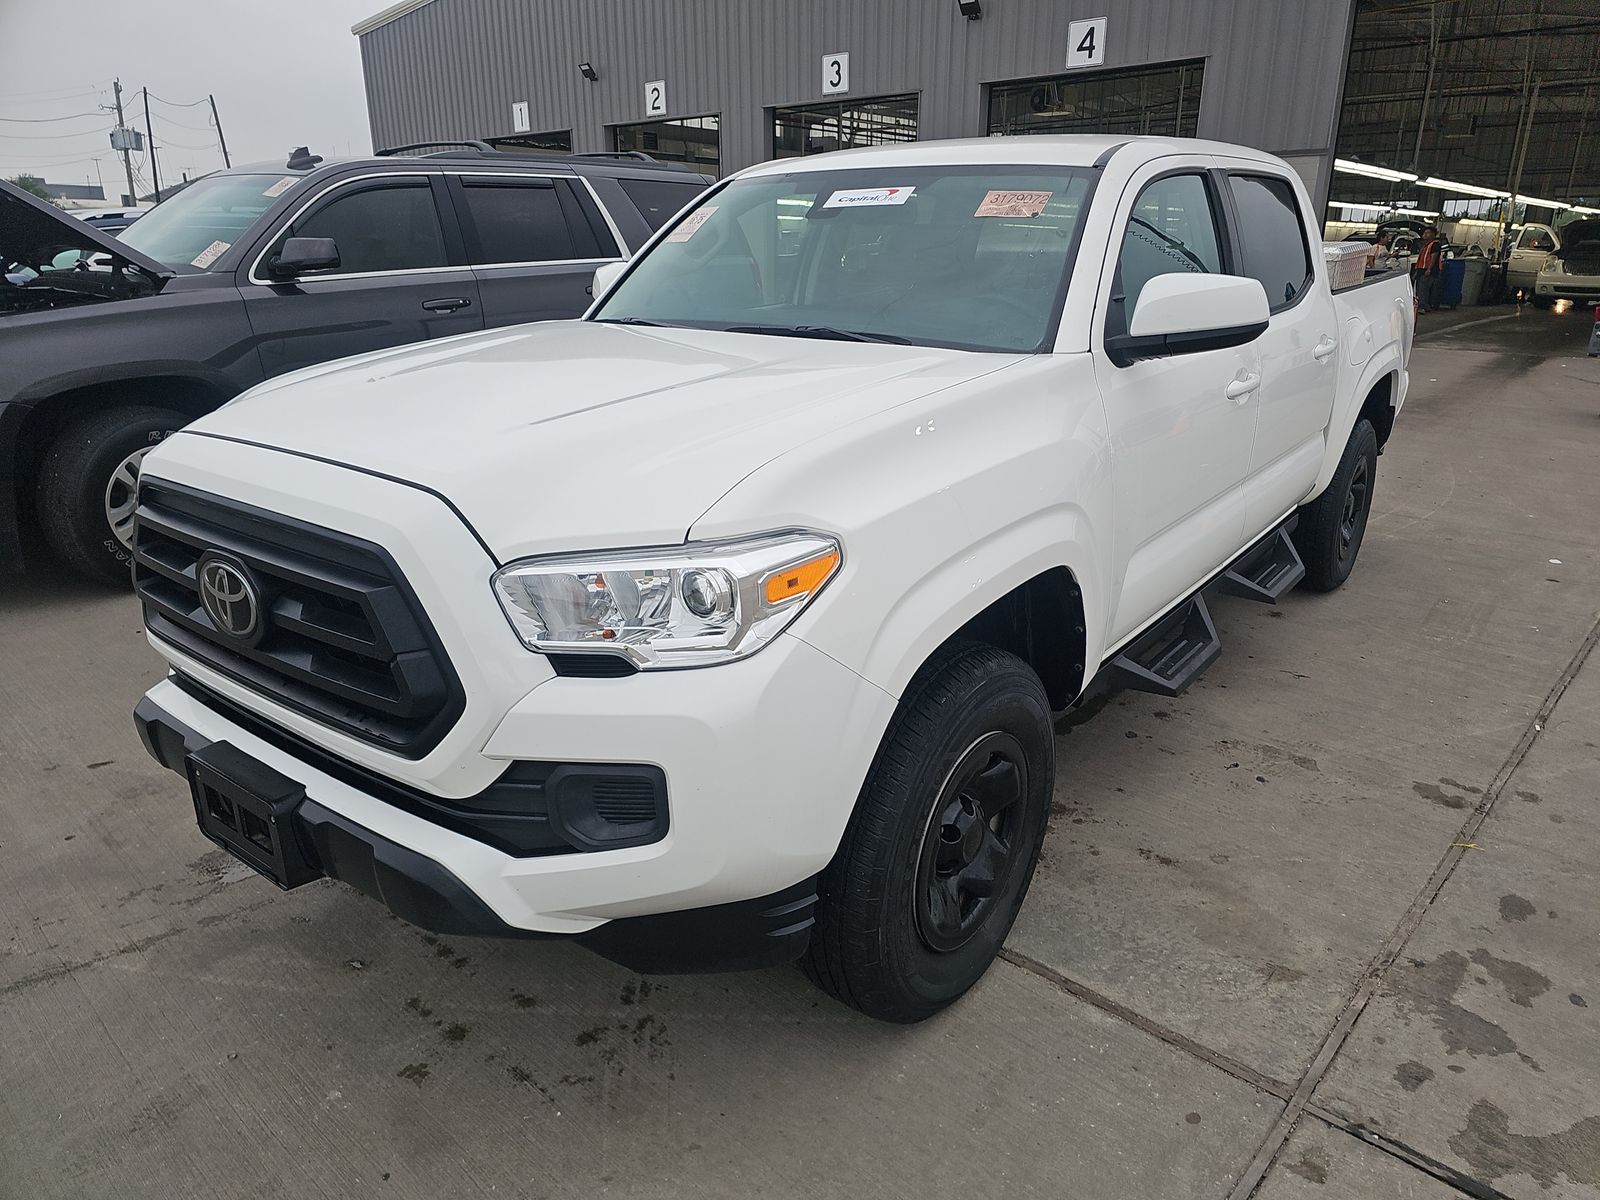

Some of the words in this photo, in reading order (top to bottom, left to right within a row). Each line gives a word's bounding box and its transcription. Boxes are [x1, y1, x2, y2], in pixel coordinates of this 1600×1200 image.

[1076, 26, 1096, 59] 4
[829, 60, 842, 88] 3
[650, 87, 661, 111] 2
[989, 193, 1050, 205] 3179072
